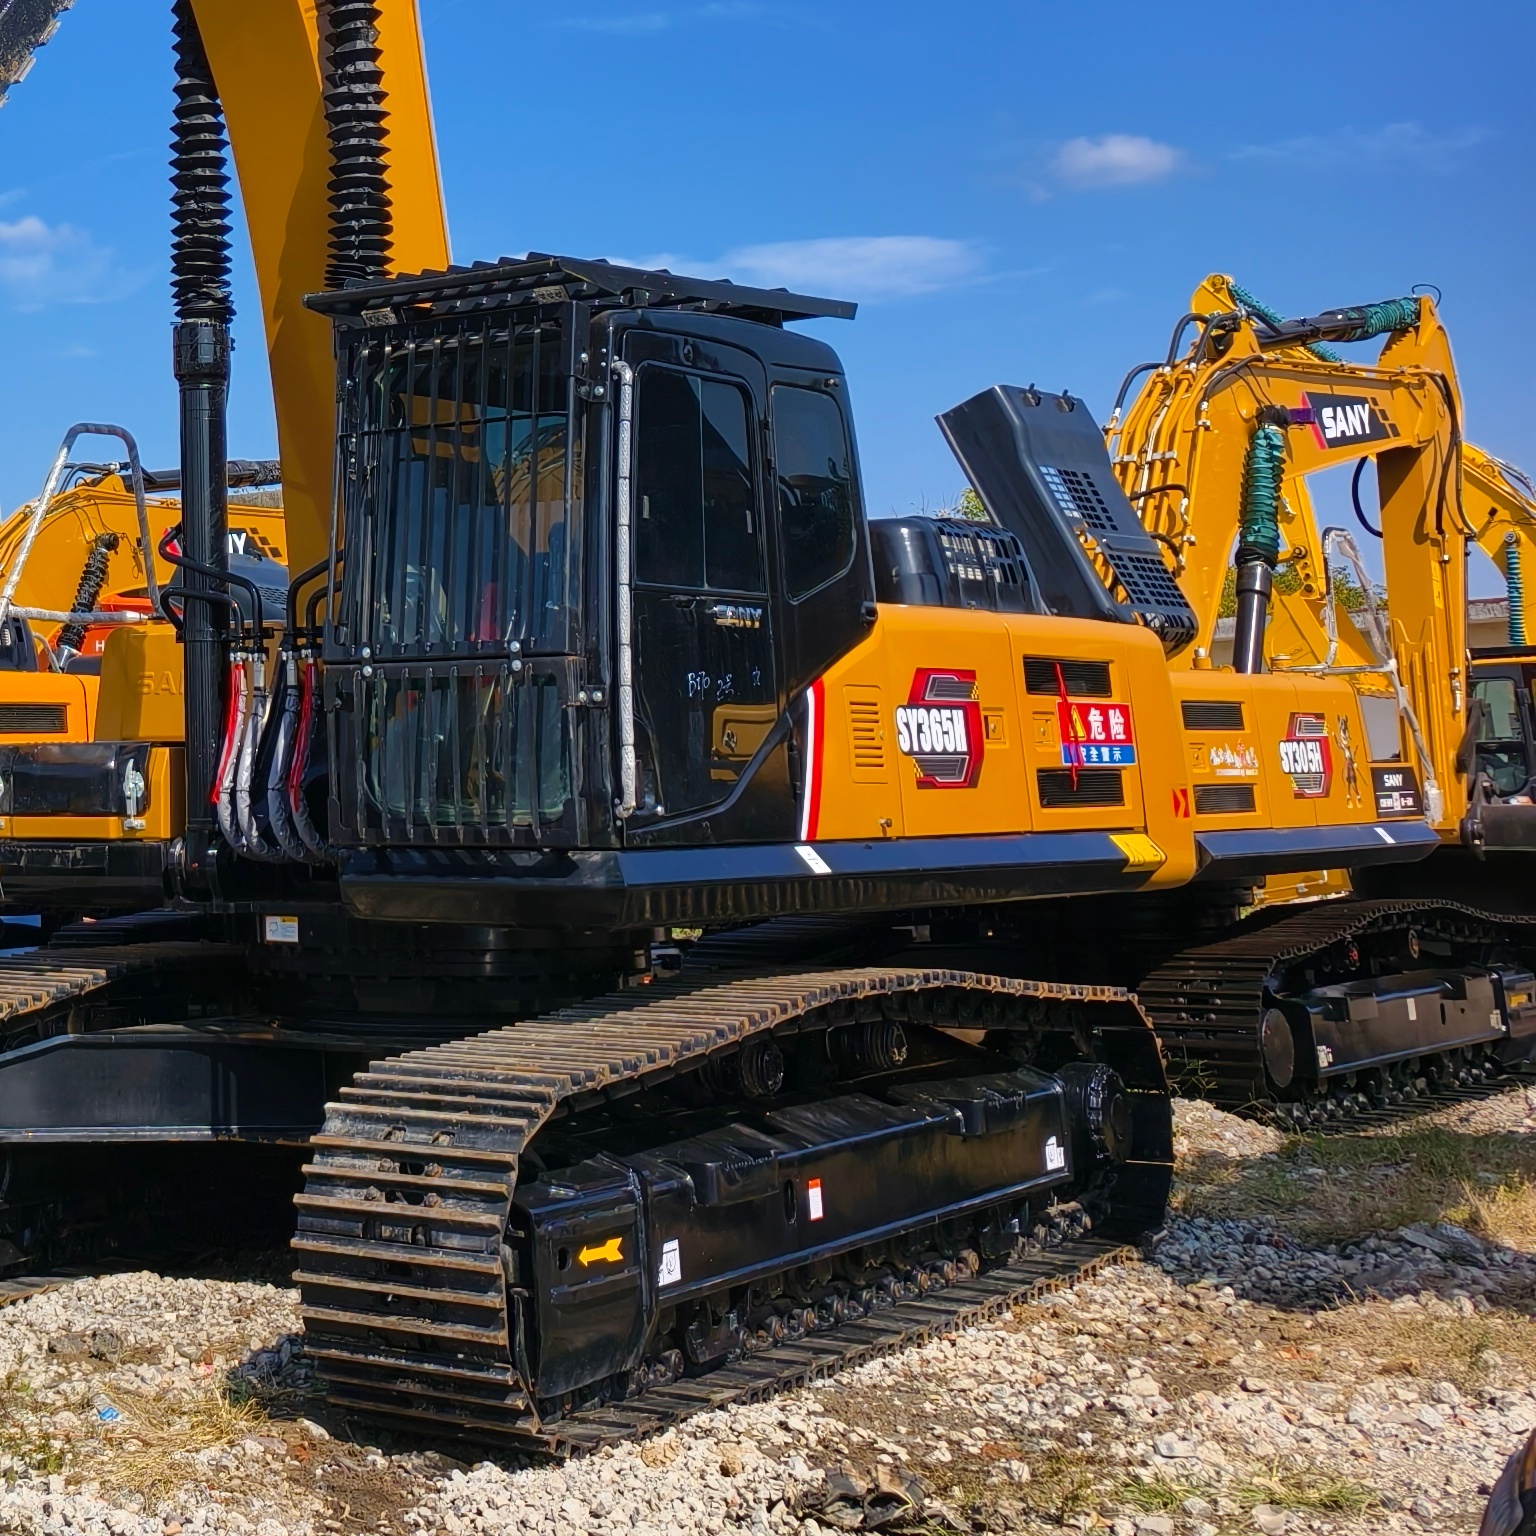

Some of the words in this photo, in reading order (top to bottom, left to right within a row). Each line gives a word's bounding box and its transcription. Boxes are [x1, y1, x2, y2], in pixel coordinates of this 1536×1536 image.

[1322, 404, 1370, 439] SANY
[896, 707, 968, 752] SY365H
[1088, 707, 1126, 740] 危险
[1279, 741, 1324, 773] SY305H
[1383, 774, 1403, 787] SANY
